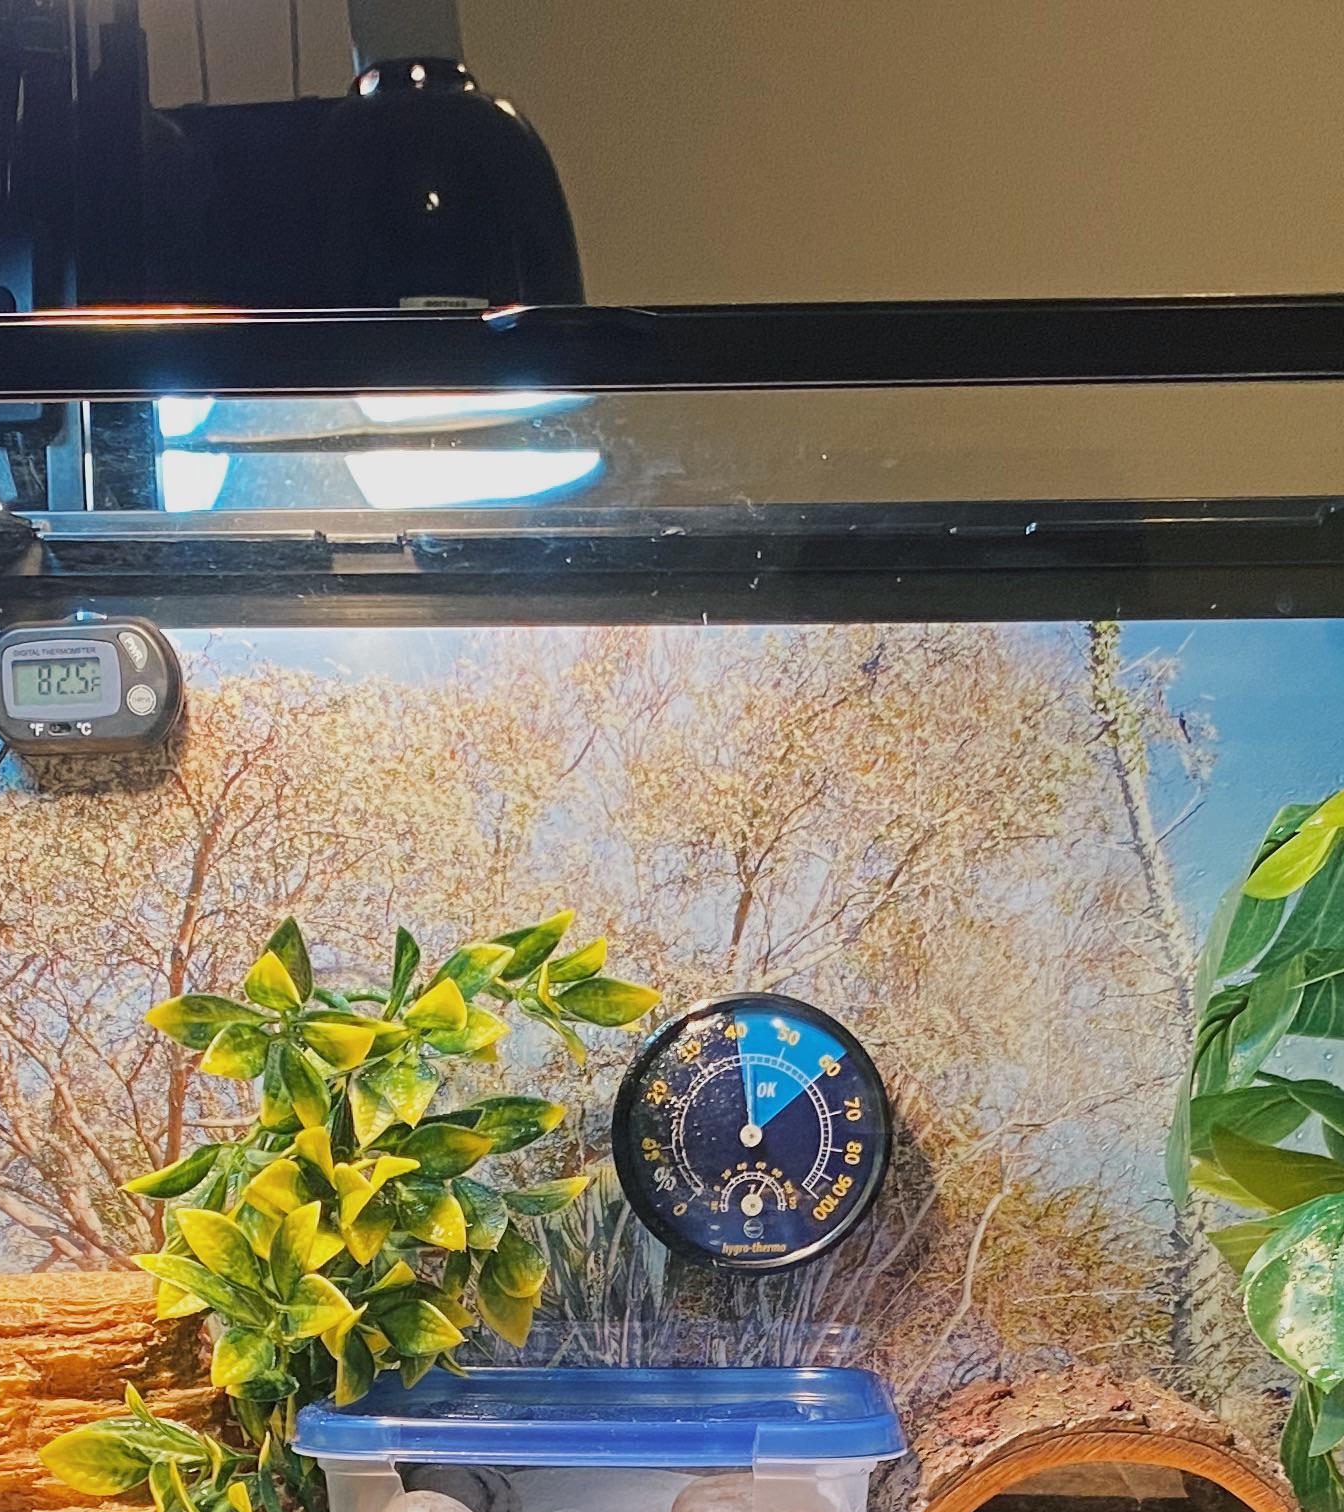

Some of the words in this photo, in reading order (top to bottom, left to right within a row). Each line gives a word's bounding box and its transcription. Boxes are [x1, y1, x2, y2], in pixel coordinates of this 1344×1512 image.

[14, 648, 40, 656] DIGITAL
[42, 647, 96, 655] THERMOMETER
[125, 637, 143, 662] PWR
[724, 1022, 748, 1040] 40
[777, 1027, 800, 1045] 50
[818, 1054, 841, 1077] 60
[756, 1081, 778, 1099] OK
[843, 1096, 862, 1121] 70
[844, 1141, 863, 1166] 80
[832, 1174, 853, 1197] 90
[672, 1202, 688, 1217] 0
[812, 1194, 839, 1221] 100
